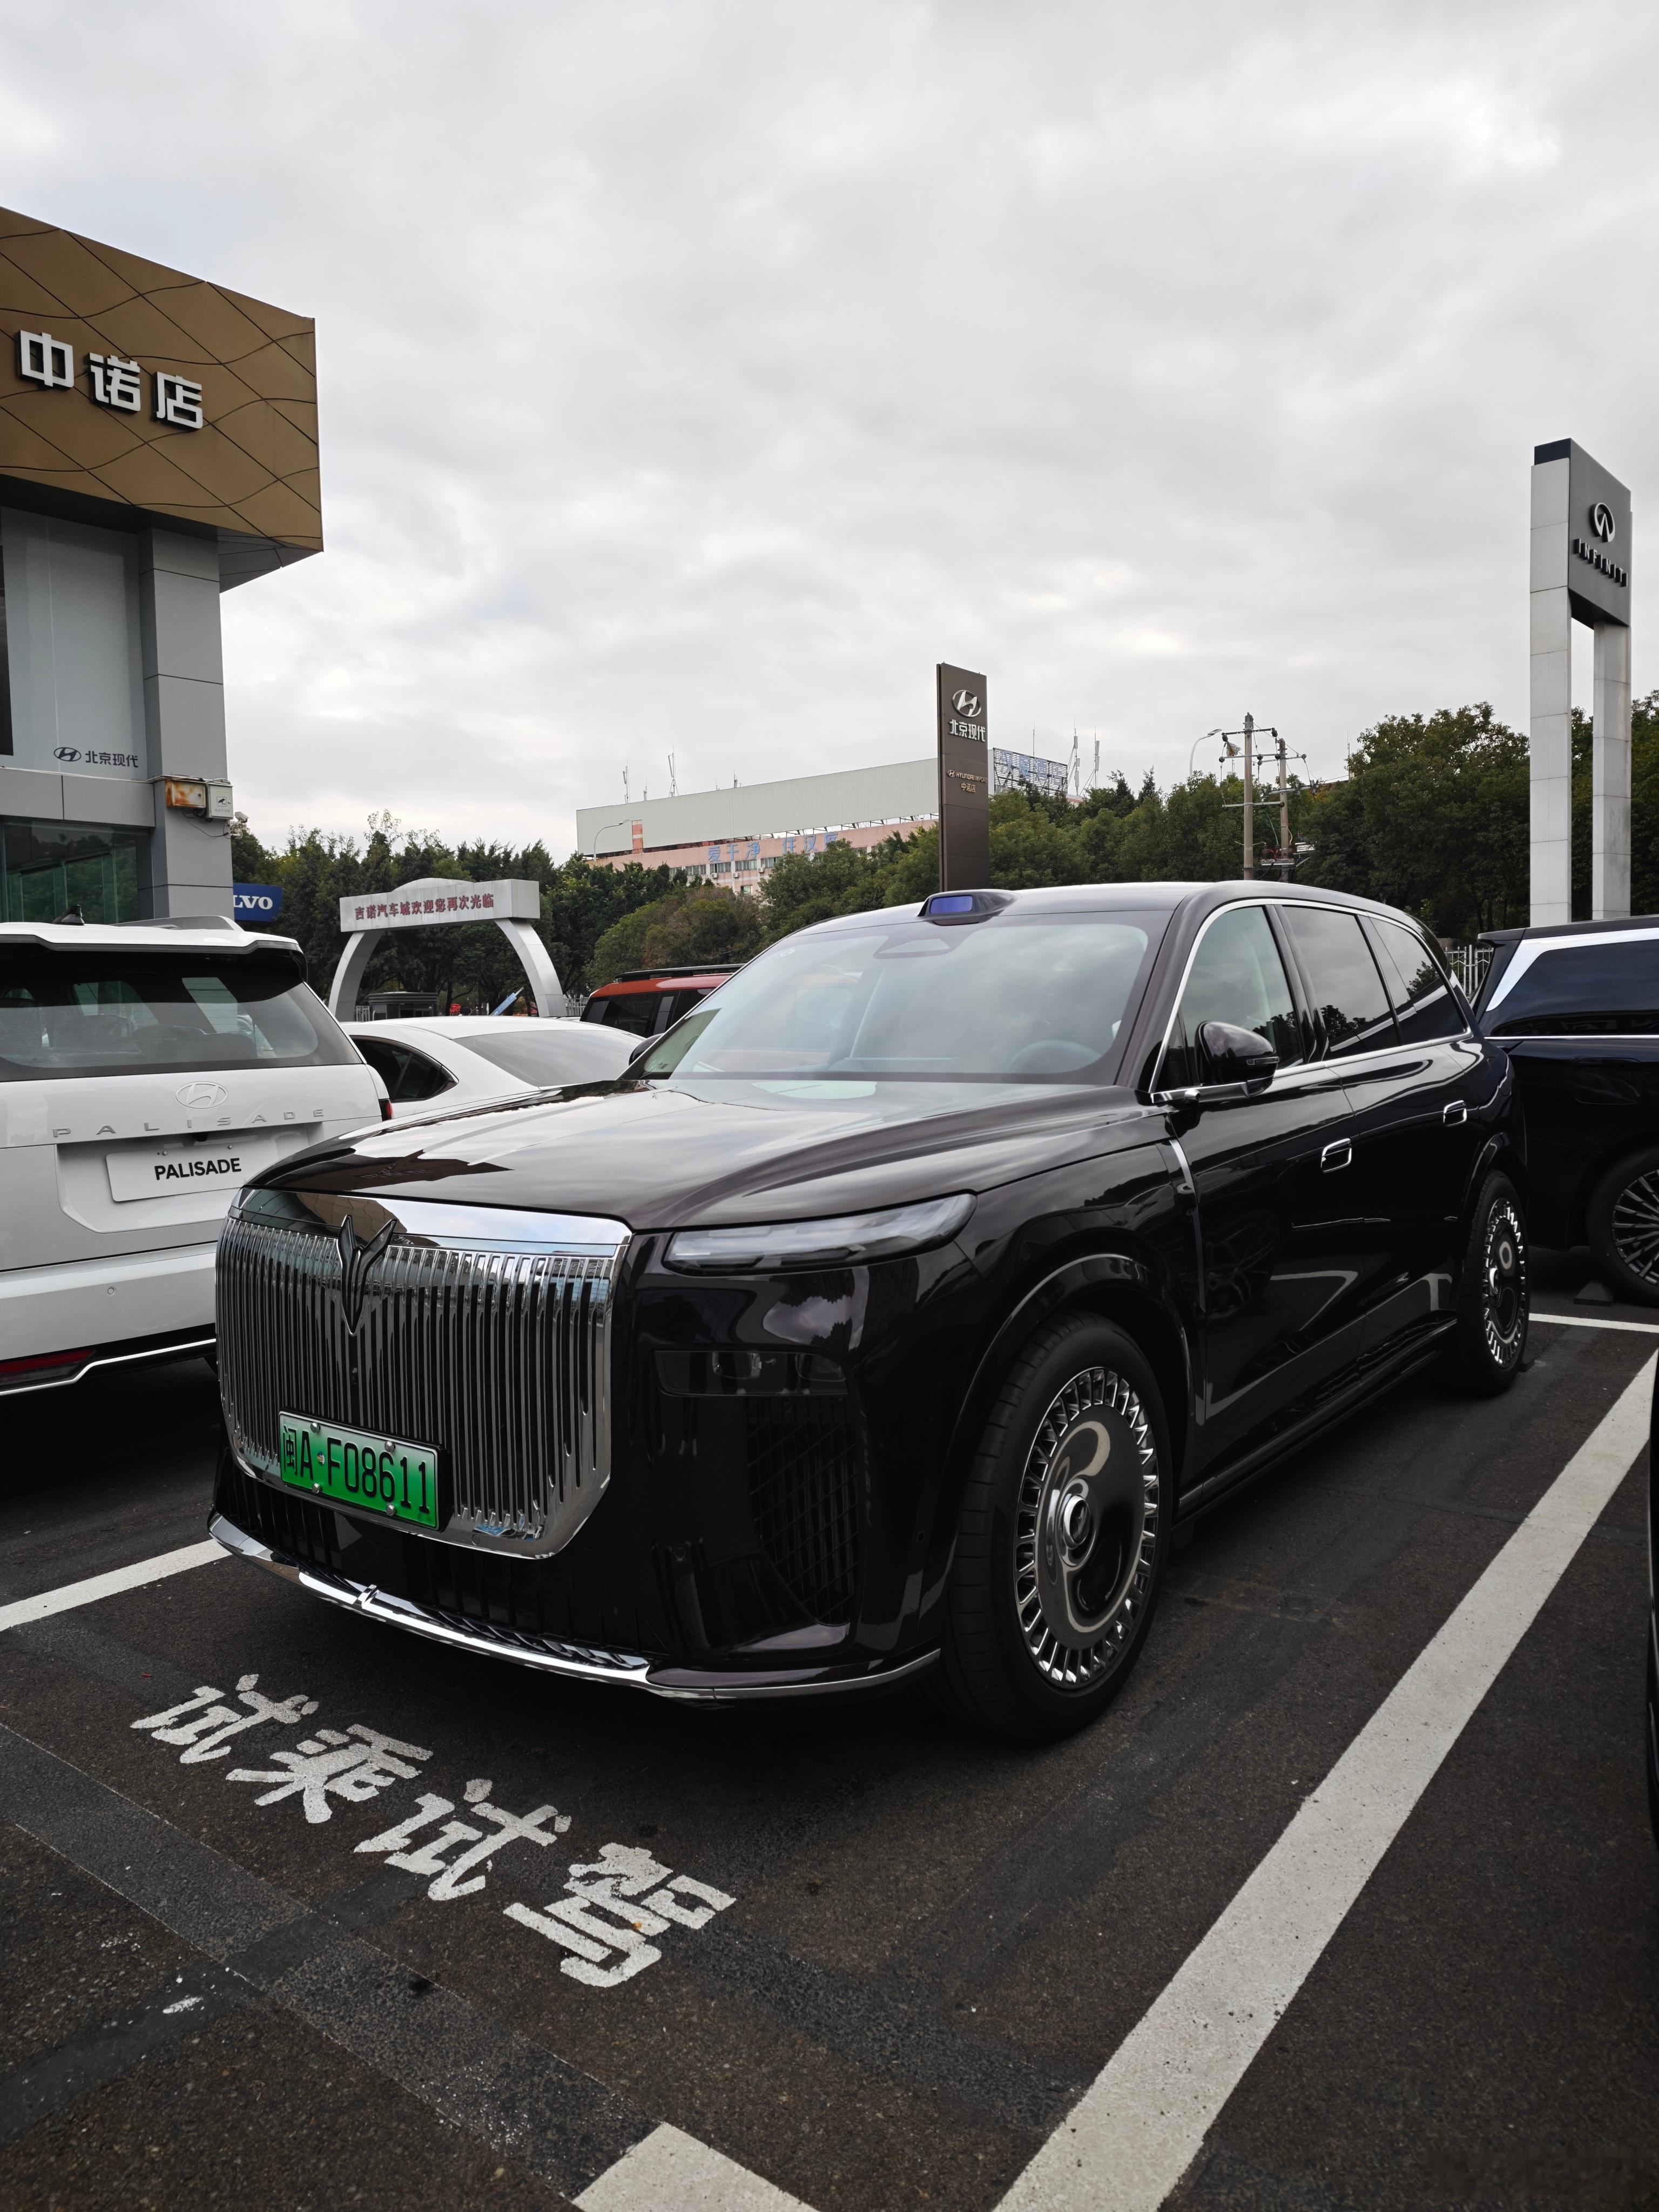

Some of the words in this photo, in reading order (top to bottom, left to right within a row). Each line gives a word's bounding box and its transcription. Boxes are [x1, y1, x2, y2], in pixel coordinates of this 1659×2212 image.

[19, 329, 203, 429] 中诺店
[1575, 538, 1628, 587] INFINITI
[949, 719, 986, 742] 北京现代
[85, 750, 139, 768] 北京现代
[956, 772, 975, 780] HYUNDAI
[975, 775, 988, 783] IMPORT
[961, 782, 976, 792] 中诺店
[708, 841, 761, 863] 爱干净
[355, 893, 494, 920] 吉诺汽车城欢迎您再次光临
[52, 1108, 325, 1138] PALISADE
[154, 1157, 242, 1181] PALISADE
[130, 1674, 738, 1988] 试乘试驾
